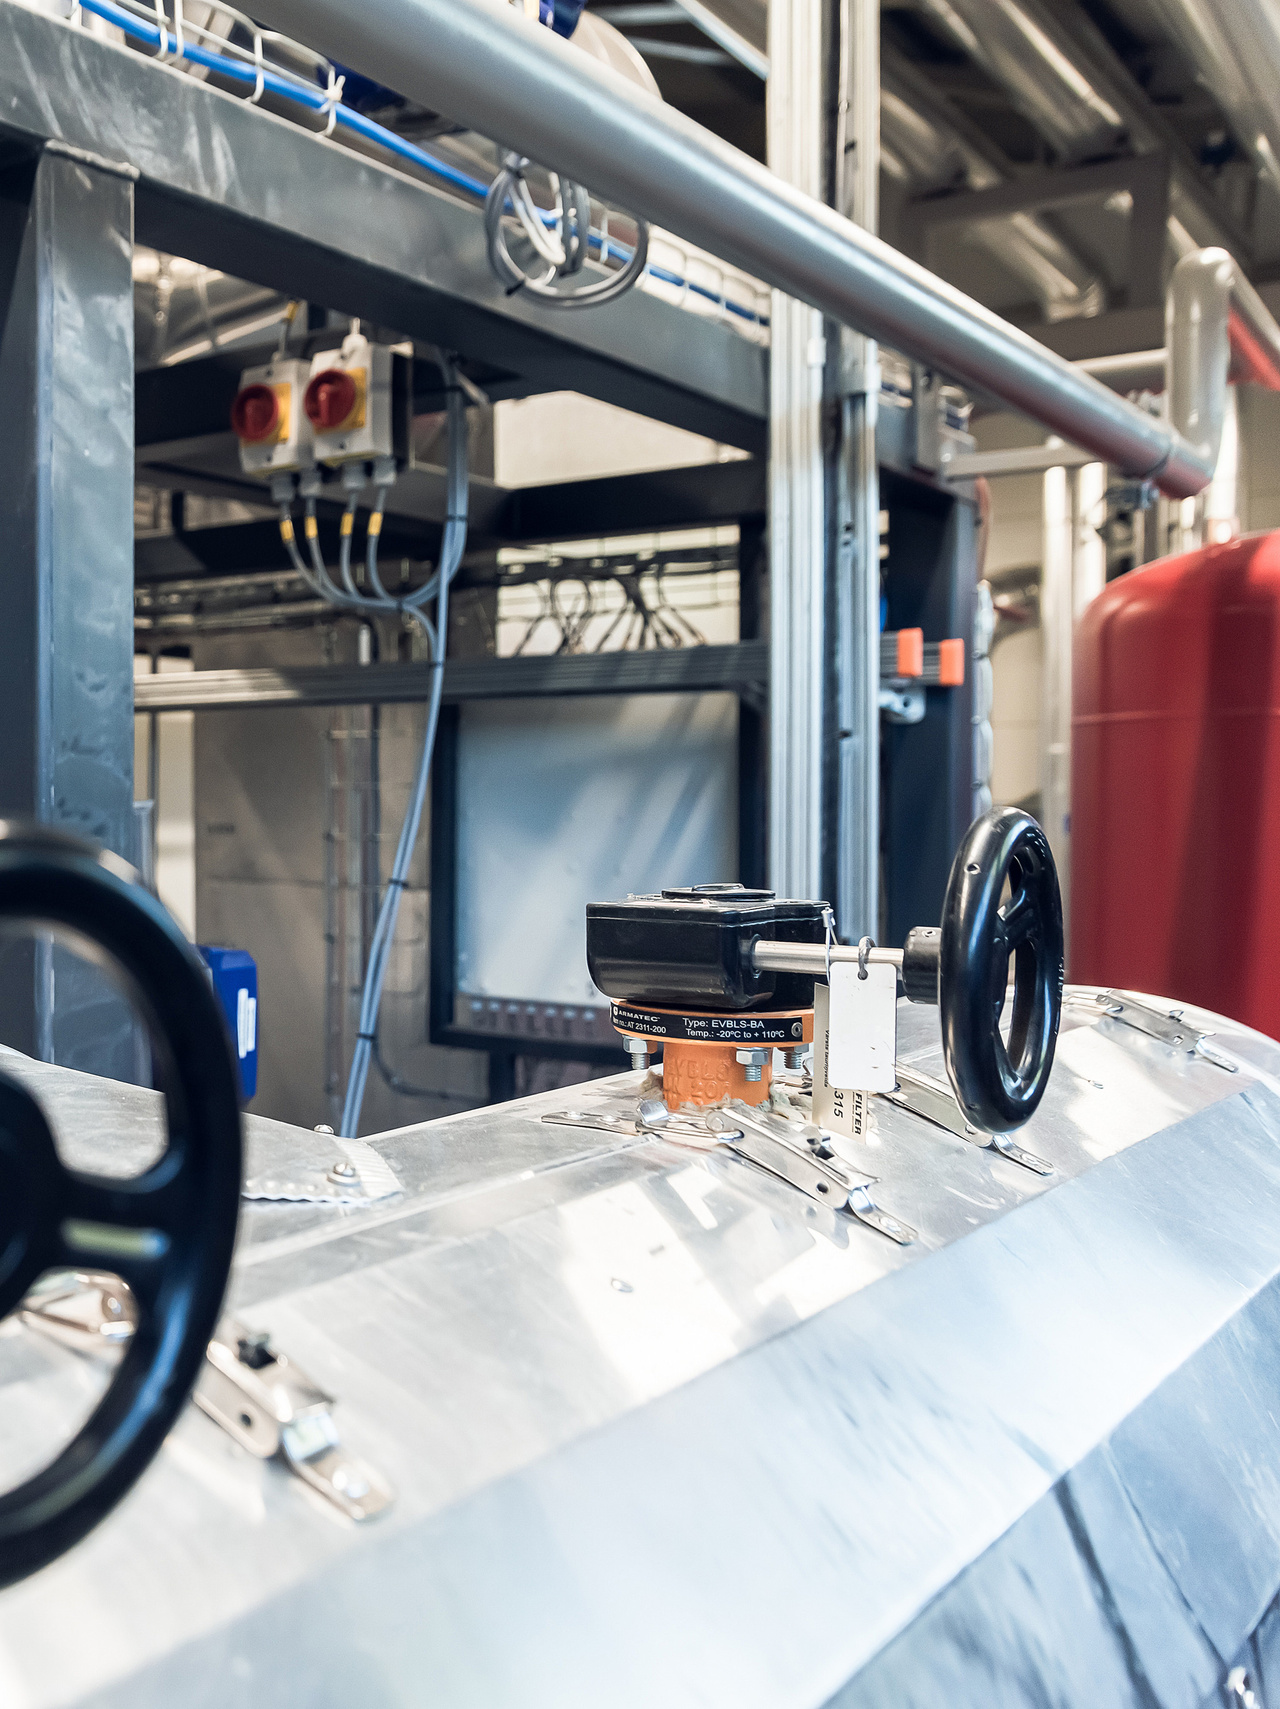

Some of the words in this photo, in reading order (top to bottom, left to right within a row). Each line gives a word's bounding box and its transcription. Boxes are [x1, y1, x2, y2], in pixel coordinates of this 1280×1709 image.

[618, 1010, 660, 1022] ARMATEC
[627, 1021, 635, 1029] AT
[635, 1023, 667, 1034] 2311-200
[682, 1017, 709, 1028] Type:
[711, 1019, 765, 1029] EVBLS-BA
[685, 1028, 714, 1038] Temp.:
[743, 1031, 752, 1039] to
[833, 1088, 844, 1118] 315
[854, 1089, 863, 1135] FILTER
